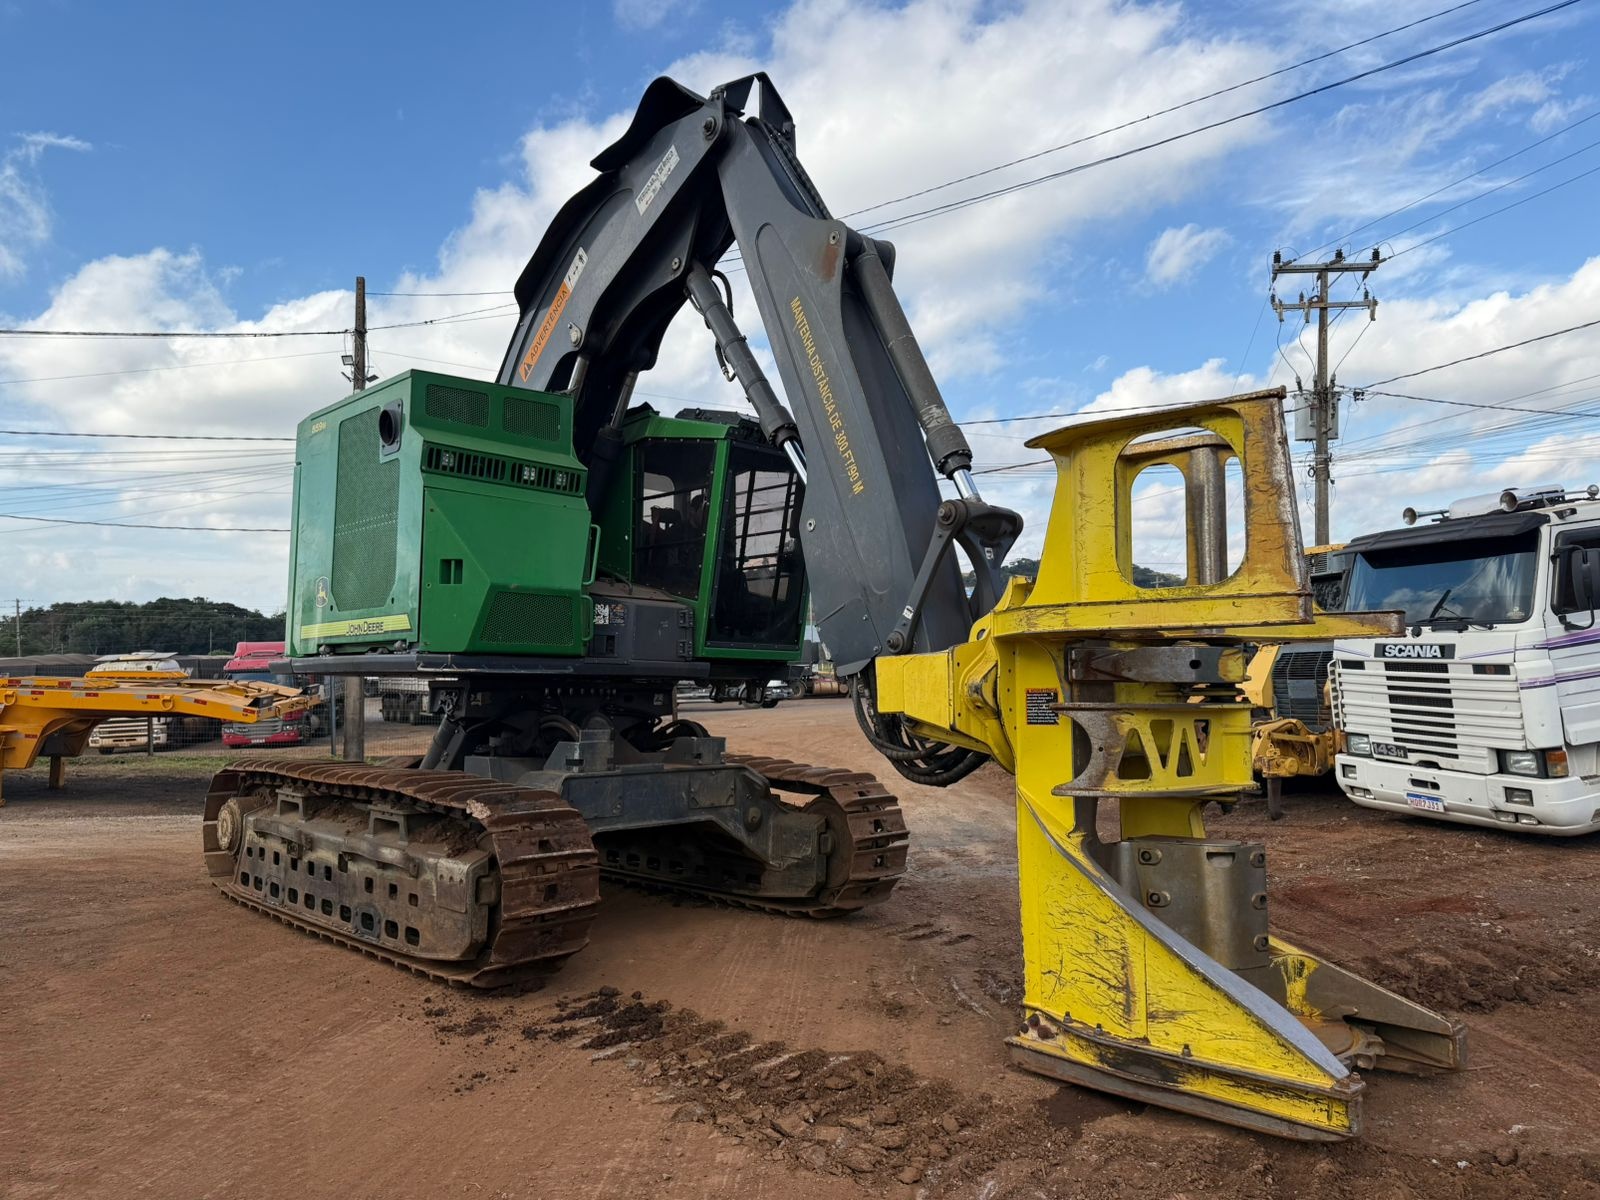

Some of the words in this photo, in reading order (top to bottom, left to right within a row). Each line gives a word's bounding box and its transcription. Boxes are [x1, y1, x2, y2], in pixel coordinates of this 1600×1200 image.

[790, 296, 816, 359] MANTENHA
[829, 412, 842, 432] DE
[852, 480, 864, 495] M
[346, 622, 363, 634] JOHN
[363, 621, 384, 632] DEERE
[1384, 644, 1442, 657] SCANIA
